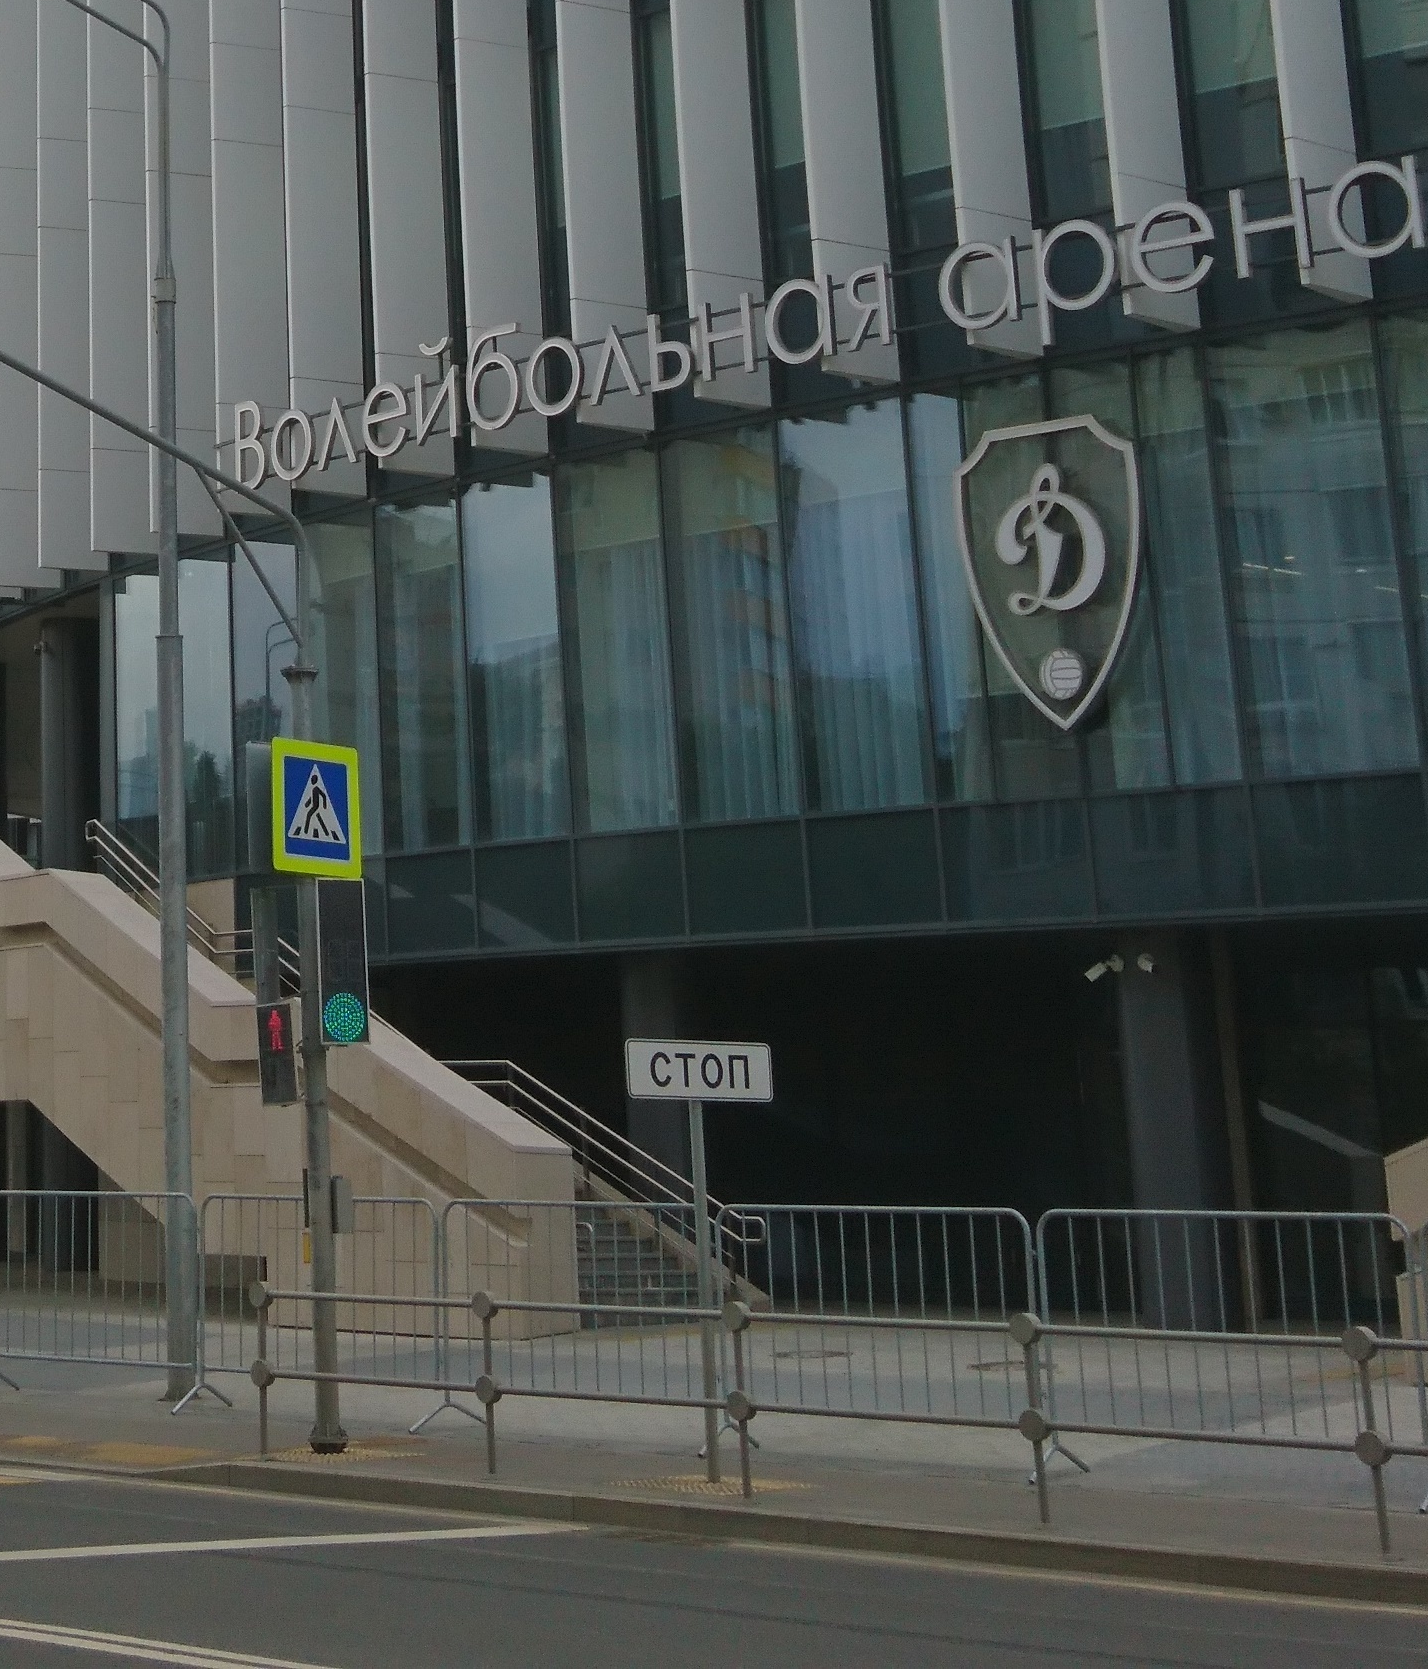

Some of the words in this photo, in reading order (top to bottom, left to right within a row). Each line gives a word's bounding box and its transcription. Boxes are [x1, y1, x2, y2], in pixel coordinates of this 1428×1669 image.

[234, 261, 893, 491] Волейбольная
[938, 154, 1426, 346] арена
[649, 1051, 751, 1090] СТОП
